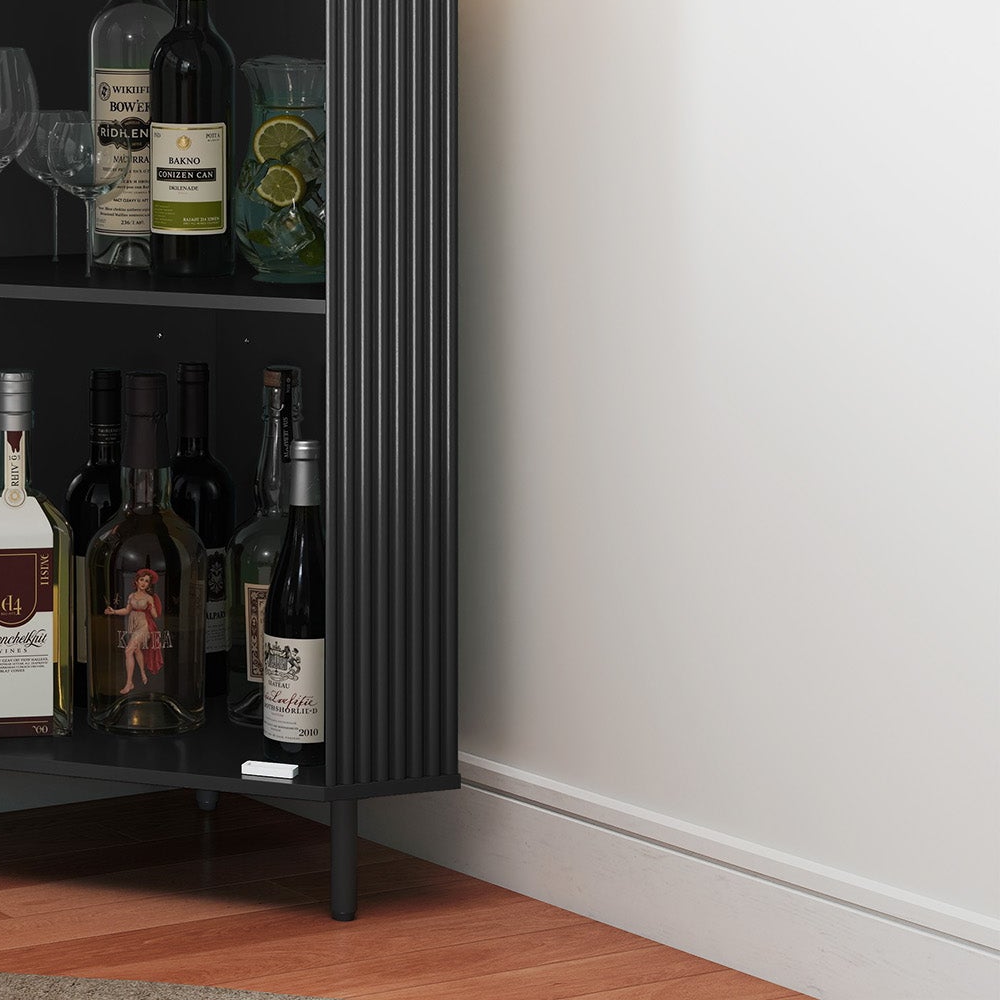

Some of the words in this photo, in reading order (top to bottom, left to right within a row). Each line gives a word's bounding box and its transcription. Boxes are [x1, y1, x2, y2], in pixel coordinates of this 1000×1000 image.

[168, 157, 201, 165] BAKNO
[196, 170, 214, 179] CAN
[298, 728, 319, 737] 2010
